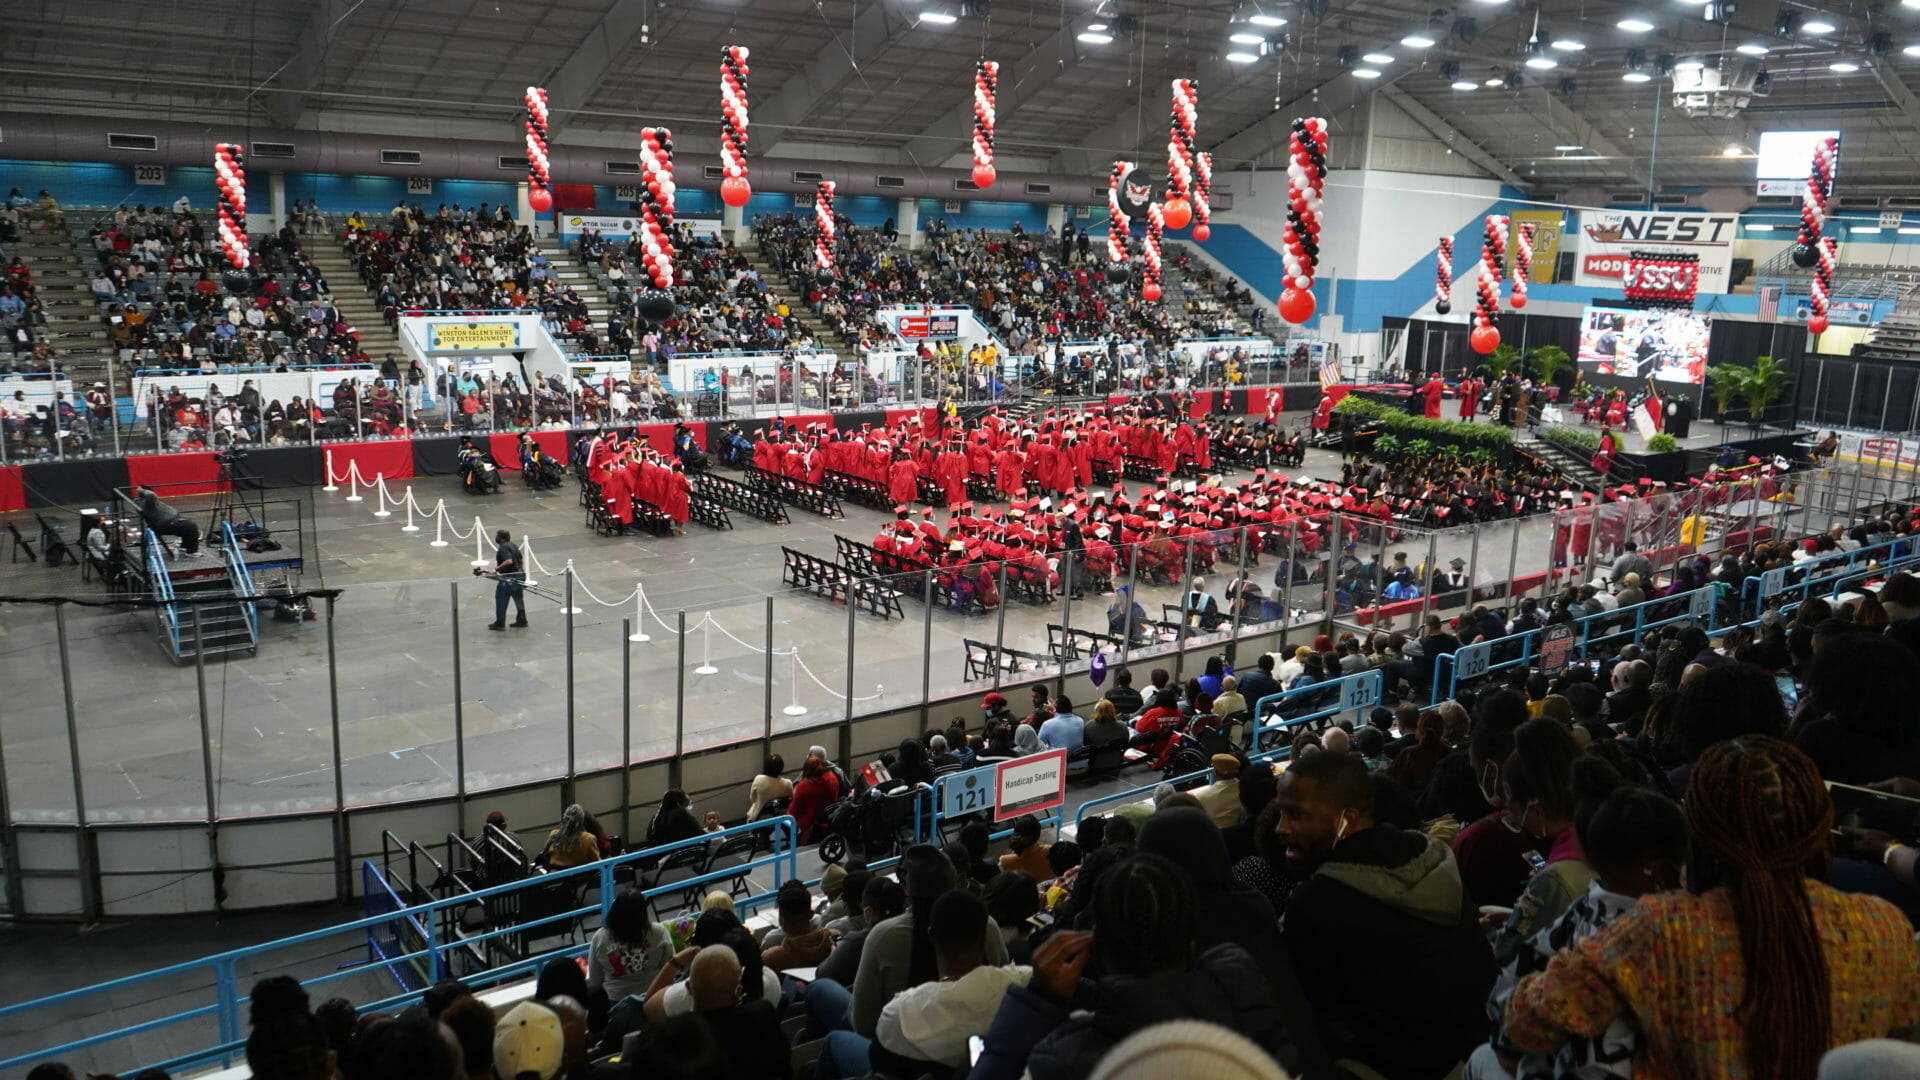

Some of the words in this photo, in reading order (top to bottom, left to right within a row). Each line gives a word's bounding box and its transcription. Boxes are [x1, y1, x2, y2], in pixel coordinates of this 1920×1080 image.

[138, 166, 162, 180] 203
[410, 177, 429, 190] 204
[618, 186, 634, 197] 205
[1619, 216, 1734, 243] NEST
[1588, 260, 1624, 272] MOD
[1623, 263, 1694, 291] WSSU
[1466, 659, 1485, 676] 120
[1350, 688, 1370, 707] 121
[1005, 775, 1034, 790] Handicap
[1034, 769, 1057, 784] Seating
[955, 787, 987, 812] 121
